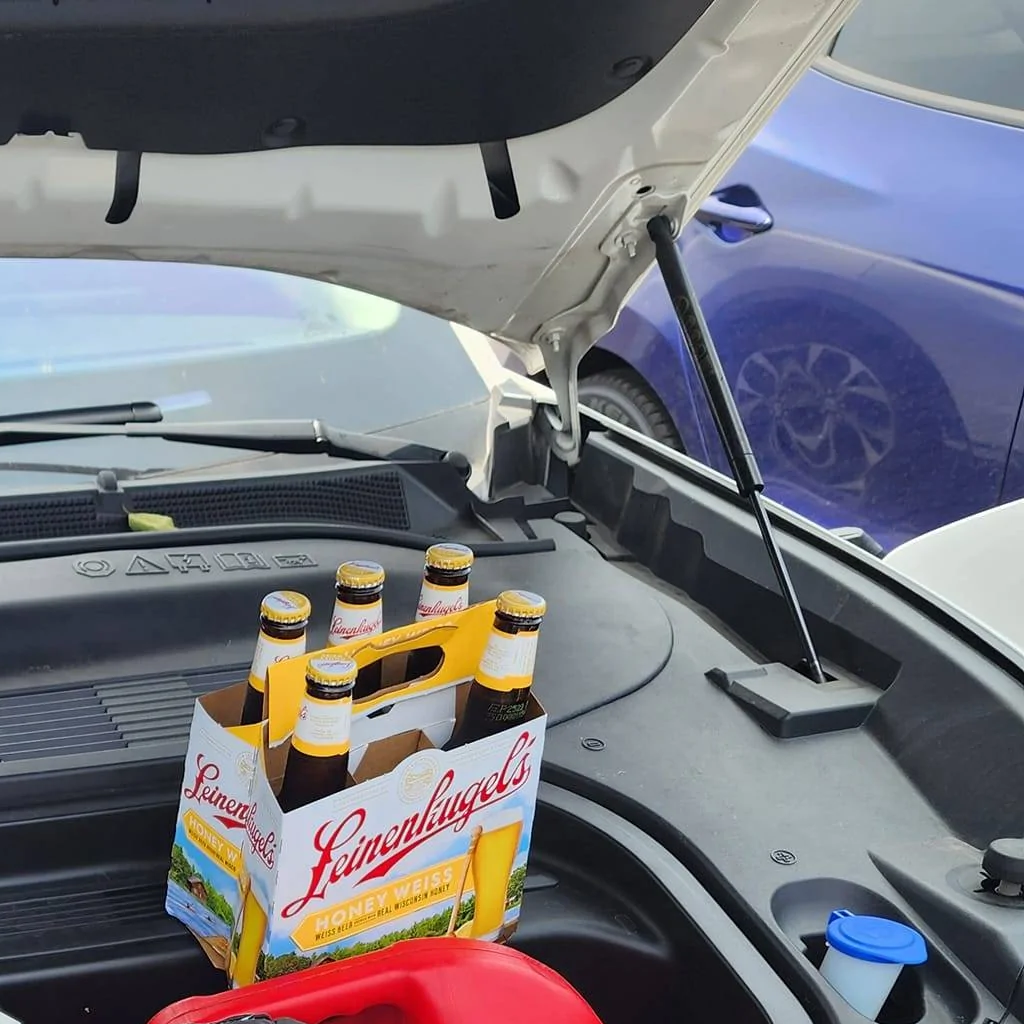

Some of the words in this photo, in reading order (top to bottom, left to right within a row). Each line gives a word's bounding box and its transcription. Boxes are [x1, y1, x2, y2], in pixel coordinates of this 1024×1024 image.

[184, 754, 277, 870] Leinenkugel's
[189, 815, 224, 851] HONEY
[281, 731, 537, 918] Leinenkugel's
[315, 891, 388, 932] HONEY
[394, 867, 453, 899] WEISS
[315, 926, 336, 941] WEISS
[377, 907, 393, 917] REAL
[394, 893, 428, 910] WISCONSIN
[429, 883, 450, 898] HONEY
